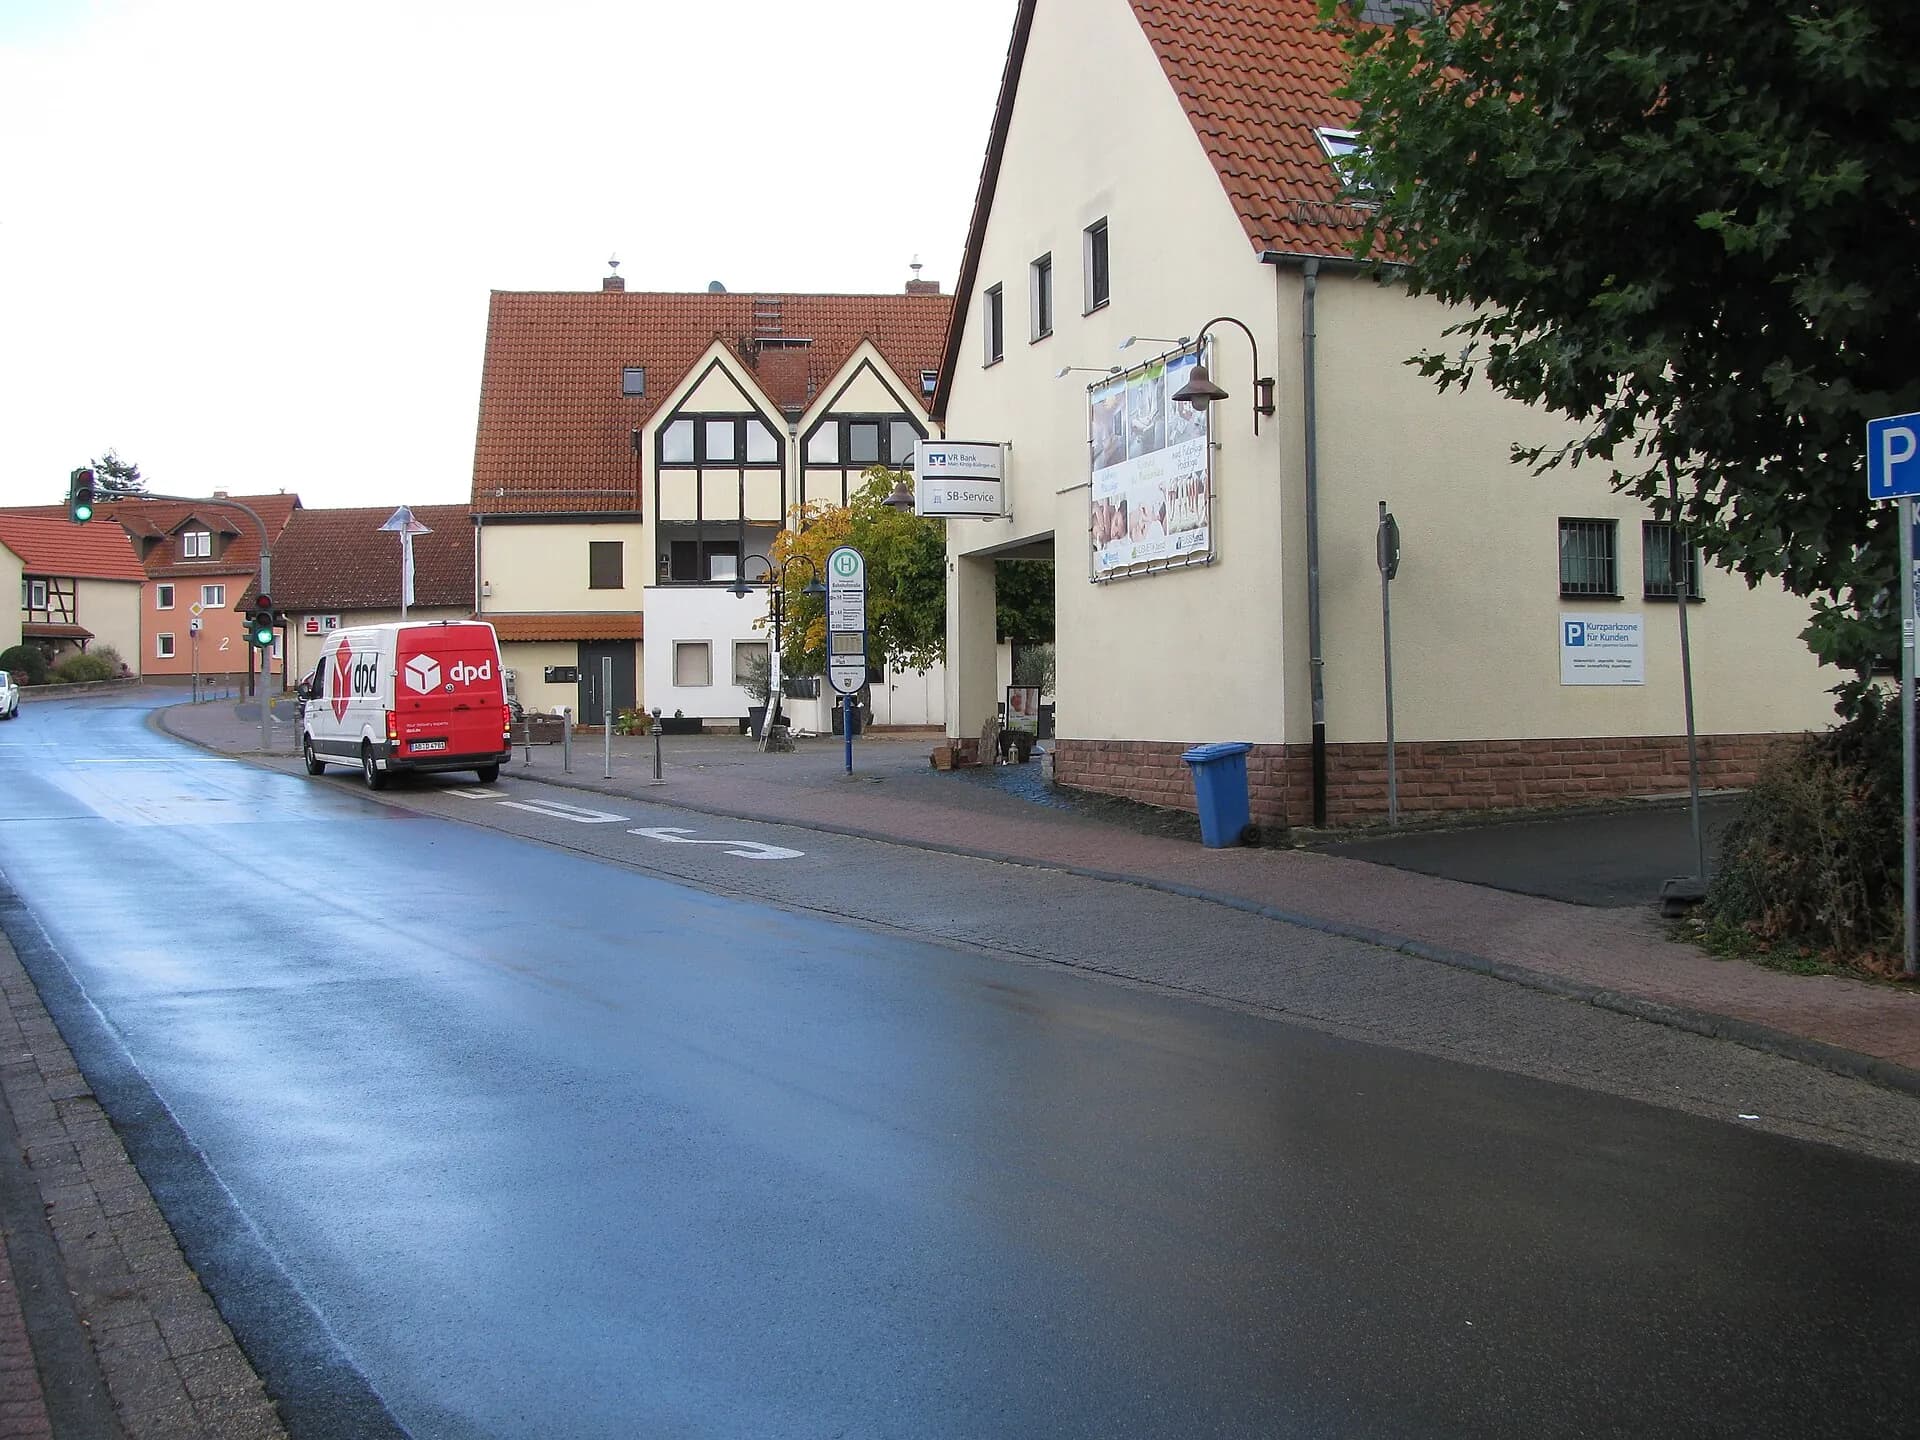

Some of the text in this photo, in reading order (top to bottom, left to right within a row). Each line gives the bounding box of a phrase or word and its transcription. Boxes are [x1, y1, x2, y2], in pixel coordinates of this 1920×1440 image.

[947, 453, 977, 462] VR Bank
[1882, 426, 1917, 487] P
[946, 491, 995, 503] SB-Service
[841, 557, 852, 572] H
[1567, 622, 1638, 644] P Kurzparkzone
[1586, 633, 1629, 642] für Kunden
[219, 637, 230, 651] 2
[354, 652, 378, 697] dpd
[450, 660, 491, 685] dpd
